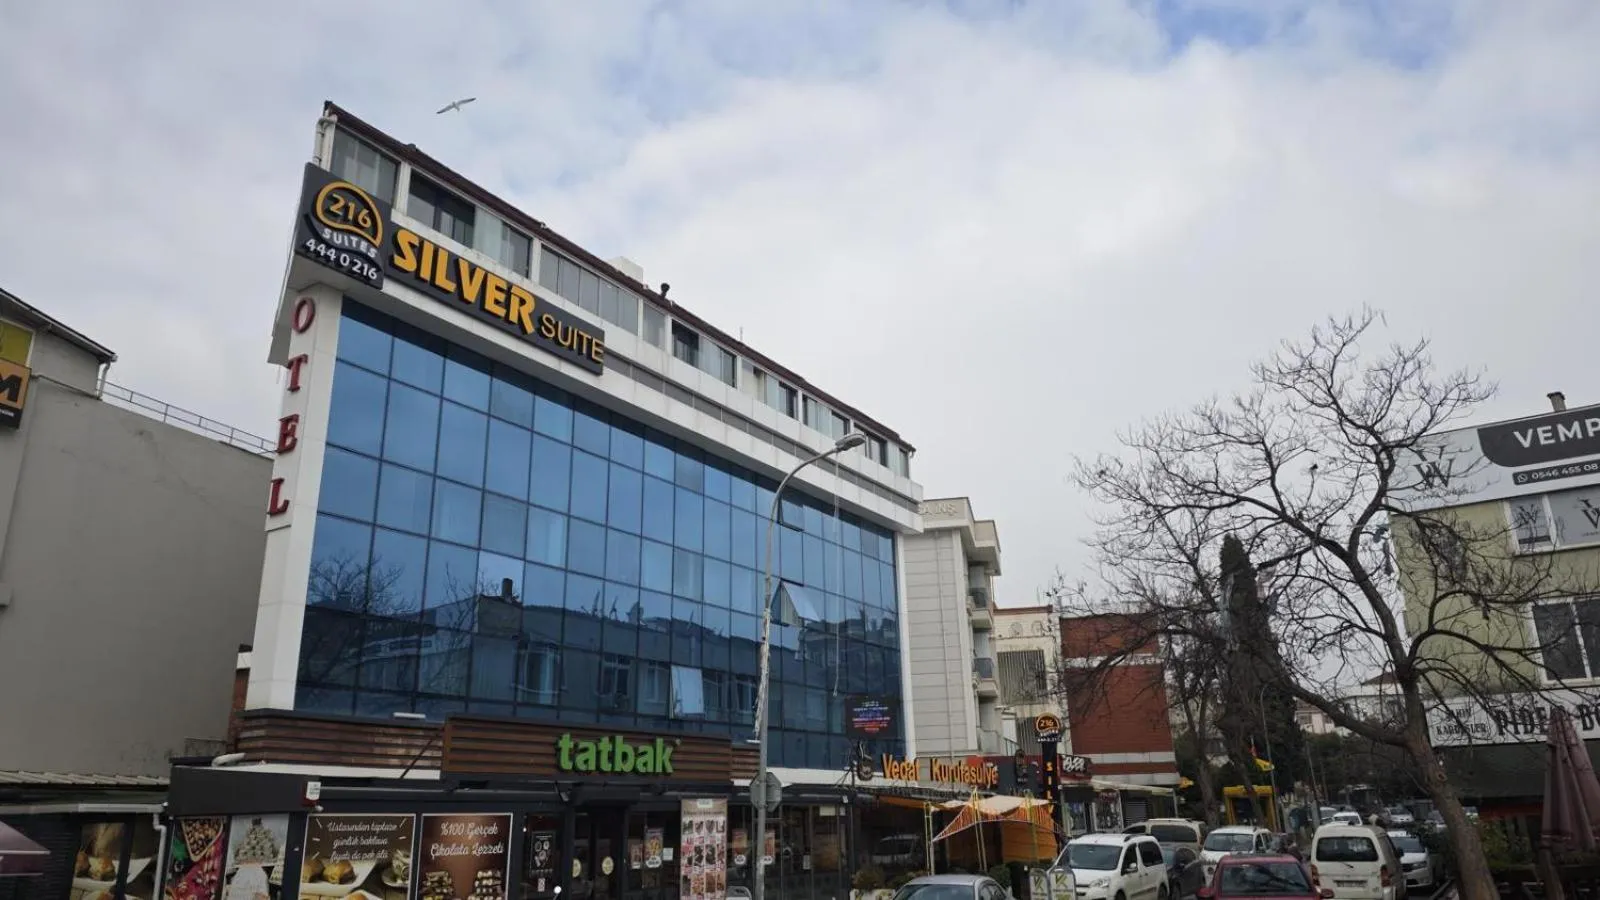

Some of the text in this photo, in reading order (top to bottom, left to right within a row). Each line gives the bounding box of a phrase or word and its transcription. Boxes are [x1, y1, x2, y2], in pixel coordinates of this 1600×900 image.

[330, 193, 372, 228] 216
[322, 228, 378, 258] SUITES
[392, 228, 605, 363] SILVER SUITE
[266, 296, 316, 518] OTEL
[1531, 469, 1560, 480] 0546
[1561, 465, 1582, 475] 455
[557, 732, 674, 774] tatbak
[881, 752, 921, 782] Vedat
